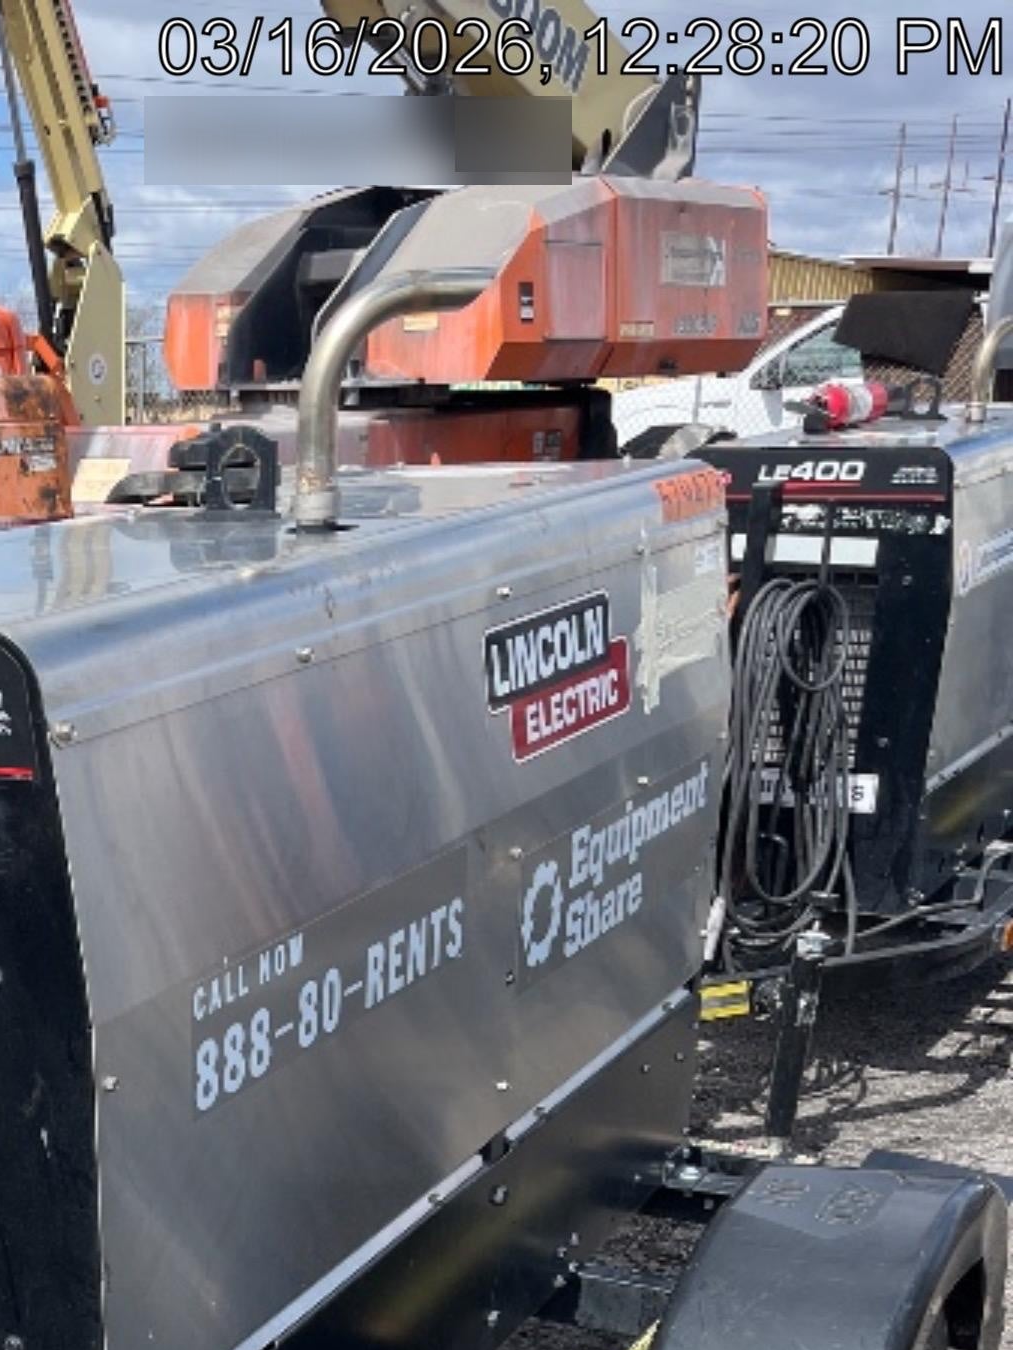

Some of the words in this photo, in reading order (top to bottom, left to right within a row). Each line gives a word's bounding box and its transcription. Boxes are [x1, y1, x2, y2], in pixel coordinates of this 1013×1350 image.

[757, 461, 866, 481] LE400
[491, 605, 603, 696] LINCOLN
[526, 669, 619, 744] ELECTRIC
[569, 761, 709, 889] Equipment
[563, 872, 643, 958] Share
[193, 965, 249, 1021] CALL
[259, 932, 304, 985] NOW
[196, 896, 464, 1112] 888-80-RENTS
